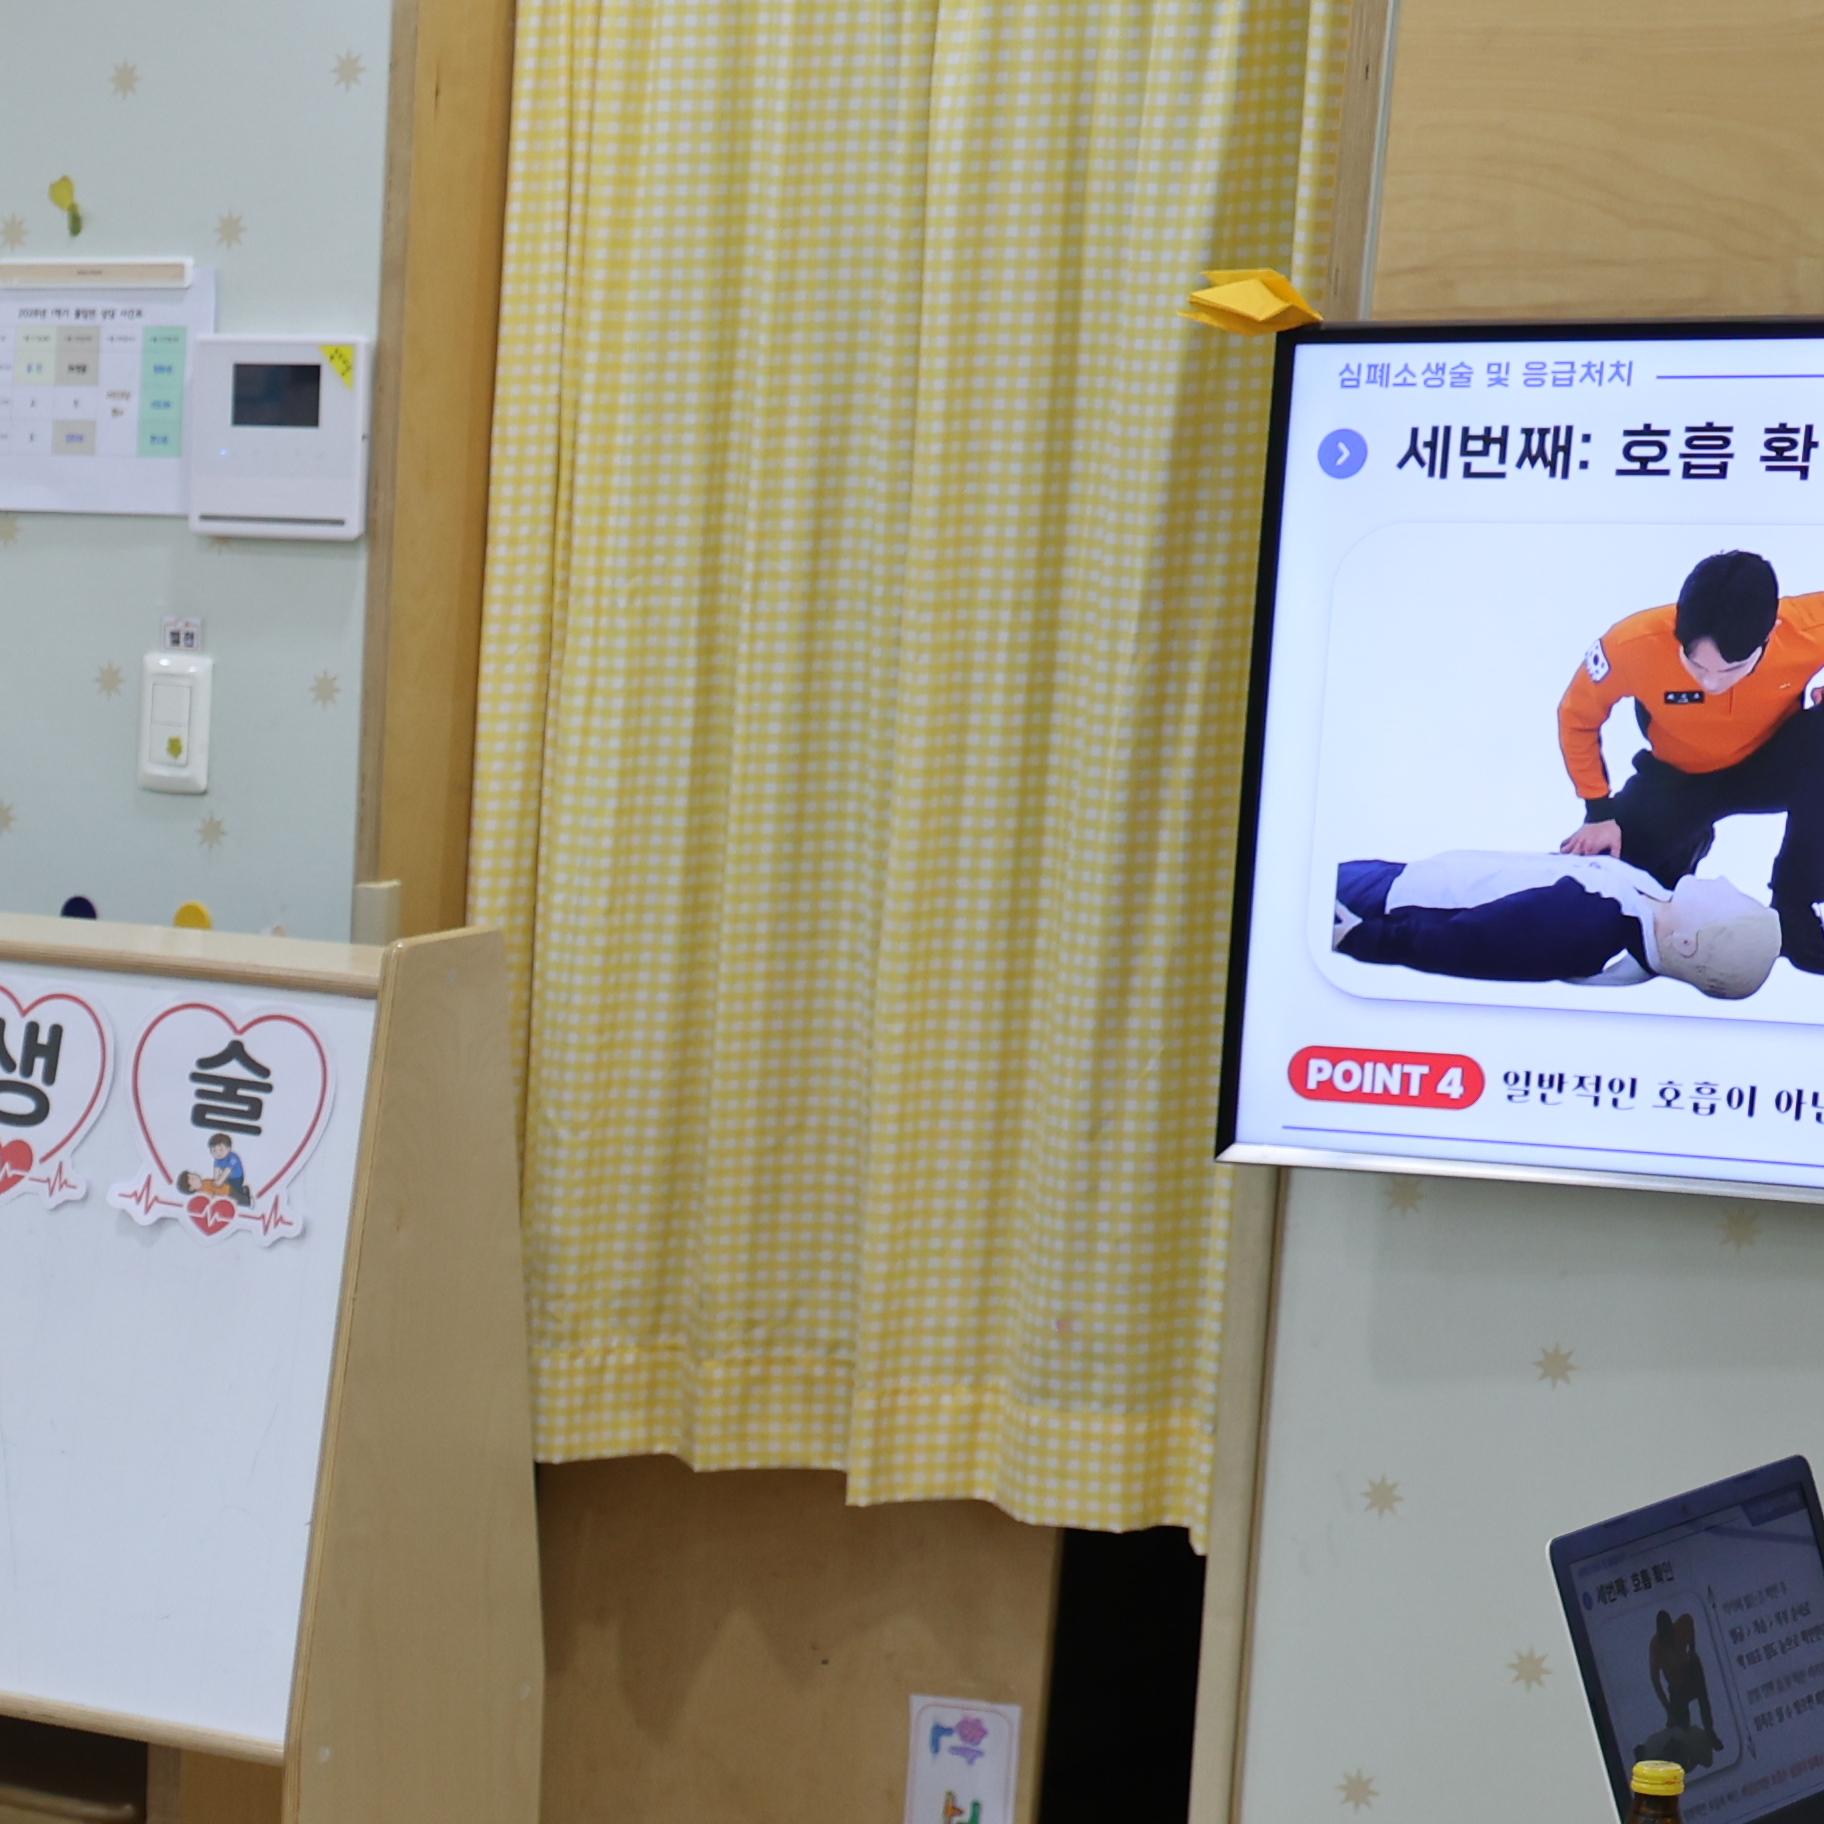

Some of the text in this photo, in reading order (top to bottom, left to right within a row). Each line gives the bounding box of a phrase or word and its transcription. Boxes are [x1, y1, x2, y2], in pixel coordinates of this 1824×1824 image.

[1337, 359, 1634, 389] 심폐소생술 및 응급처치
[1397, 424, 1591, 480] 세번째:
[1615, 420, 1735, 480] 호흡
[189, 1039, 274, 1138] 술
[1306, 1057, 1464, 1099] POINT 4
[1502, 1069, 1637, 1111] 일반적인
[1652, 1079, 1756, 1118] 호흡이
